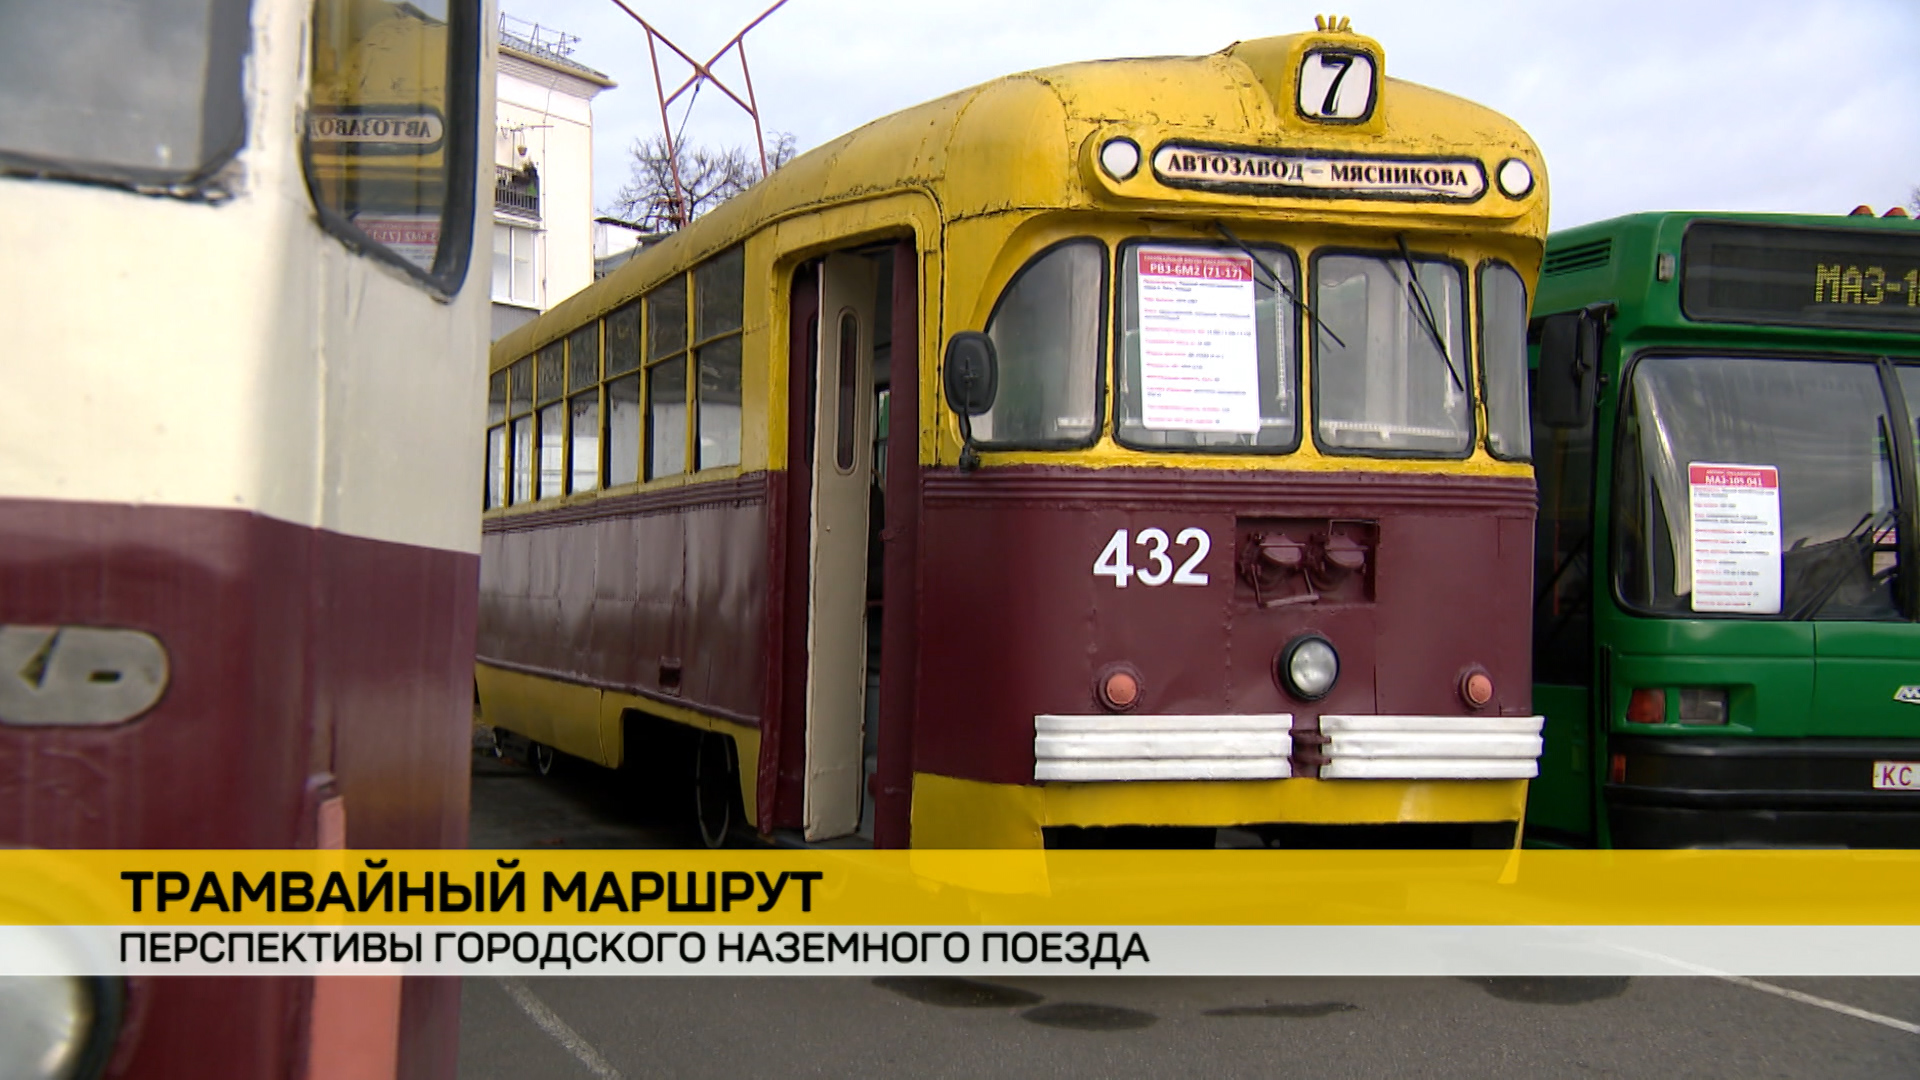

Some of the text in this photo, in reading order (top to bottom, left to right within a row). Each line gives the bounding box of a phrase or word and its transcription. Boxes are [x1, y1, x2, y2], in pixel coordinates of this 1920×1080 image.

[1320, 55, 1353, 116] 7
[1167, 152, 1304, 182] АВТОЗАВОД
[1330, 162, 1469, 186] МЯСНИКОВА
[1815, 262, 1920, 307] МАЗ-1
[1093, 527, 1211, 588] 432
